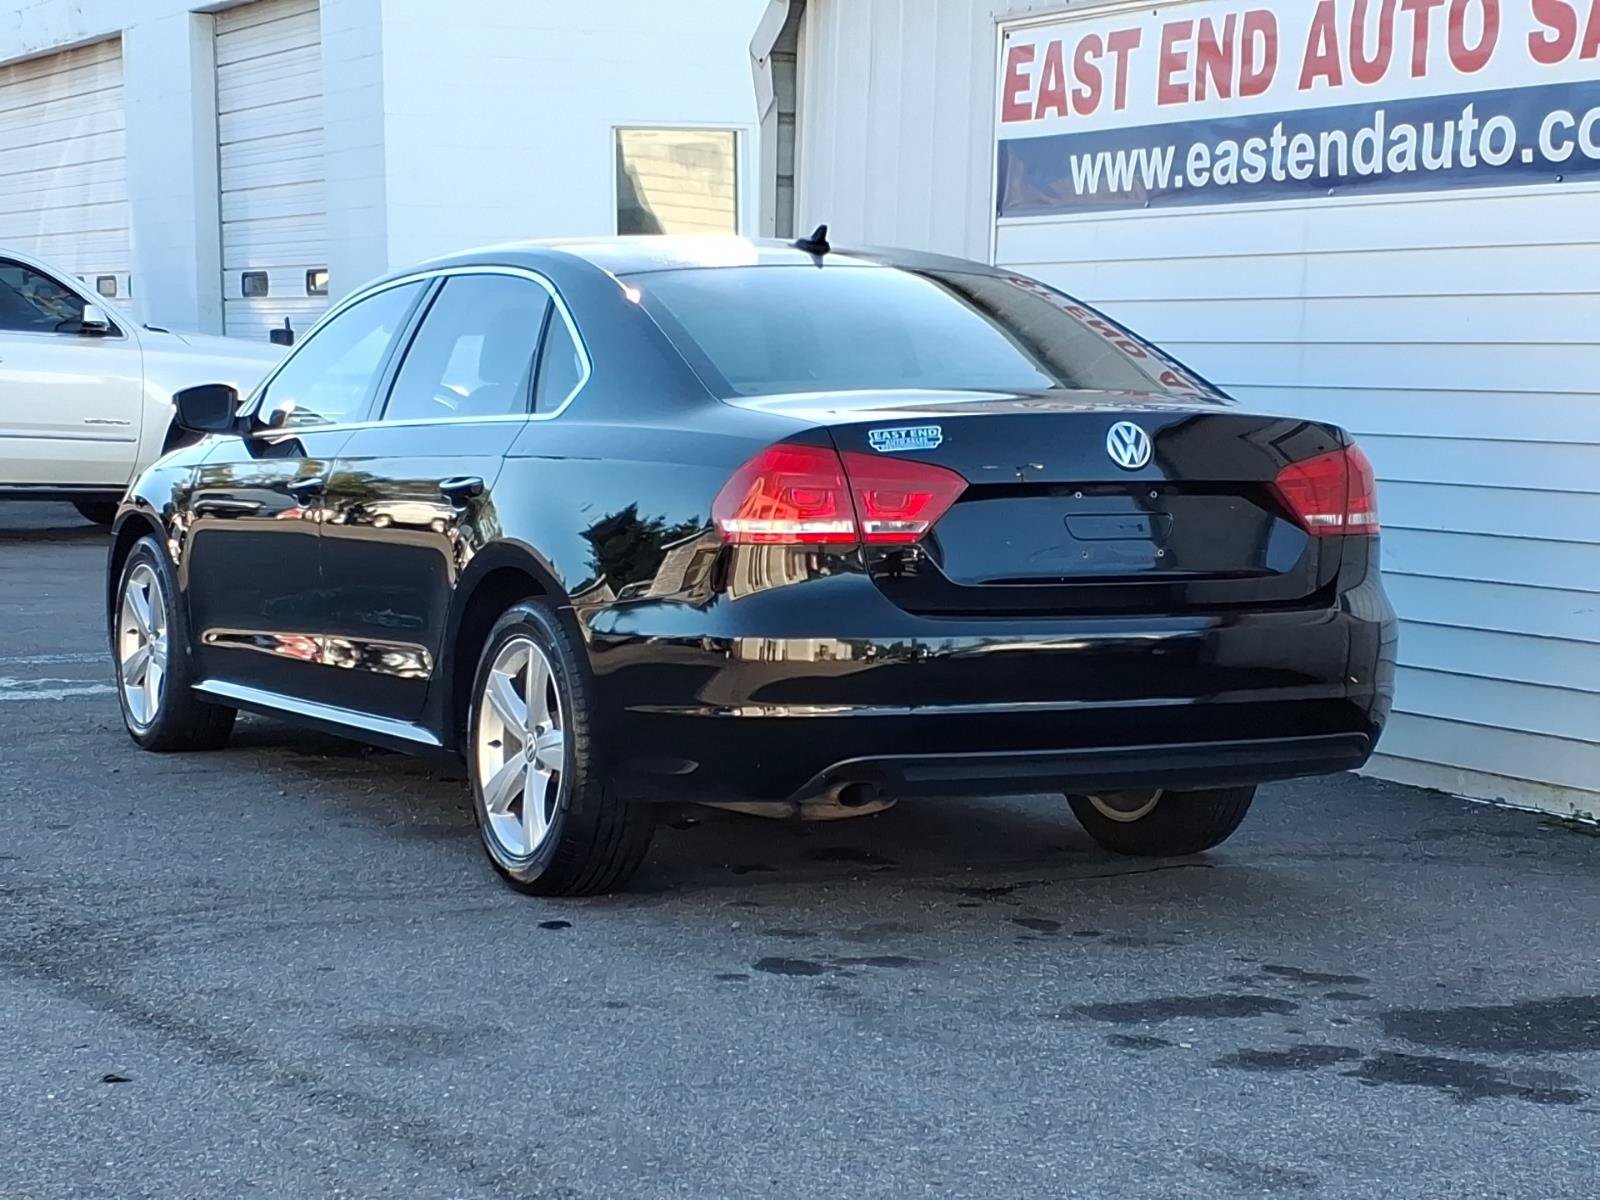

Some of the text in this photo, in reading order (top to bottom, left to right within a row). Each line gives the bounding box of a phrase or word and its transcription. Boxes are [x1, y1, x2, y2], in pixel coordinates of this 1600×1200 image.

[1001, 27, 1142, 122] EAST
[1157, 9, 1278, 106] END
[1298, 0, 1500, 91] AUTO
[873, 428, 938, 441] EAST END
[1107, 421, 1151, 468] VW
